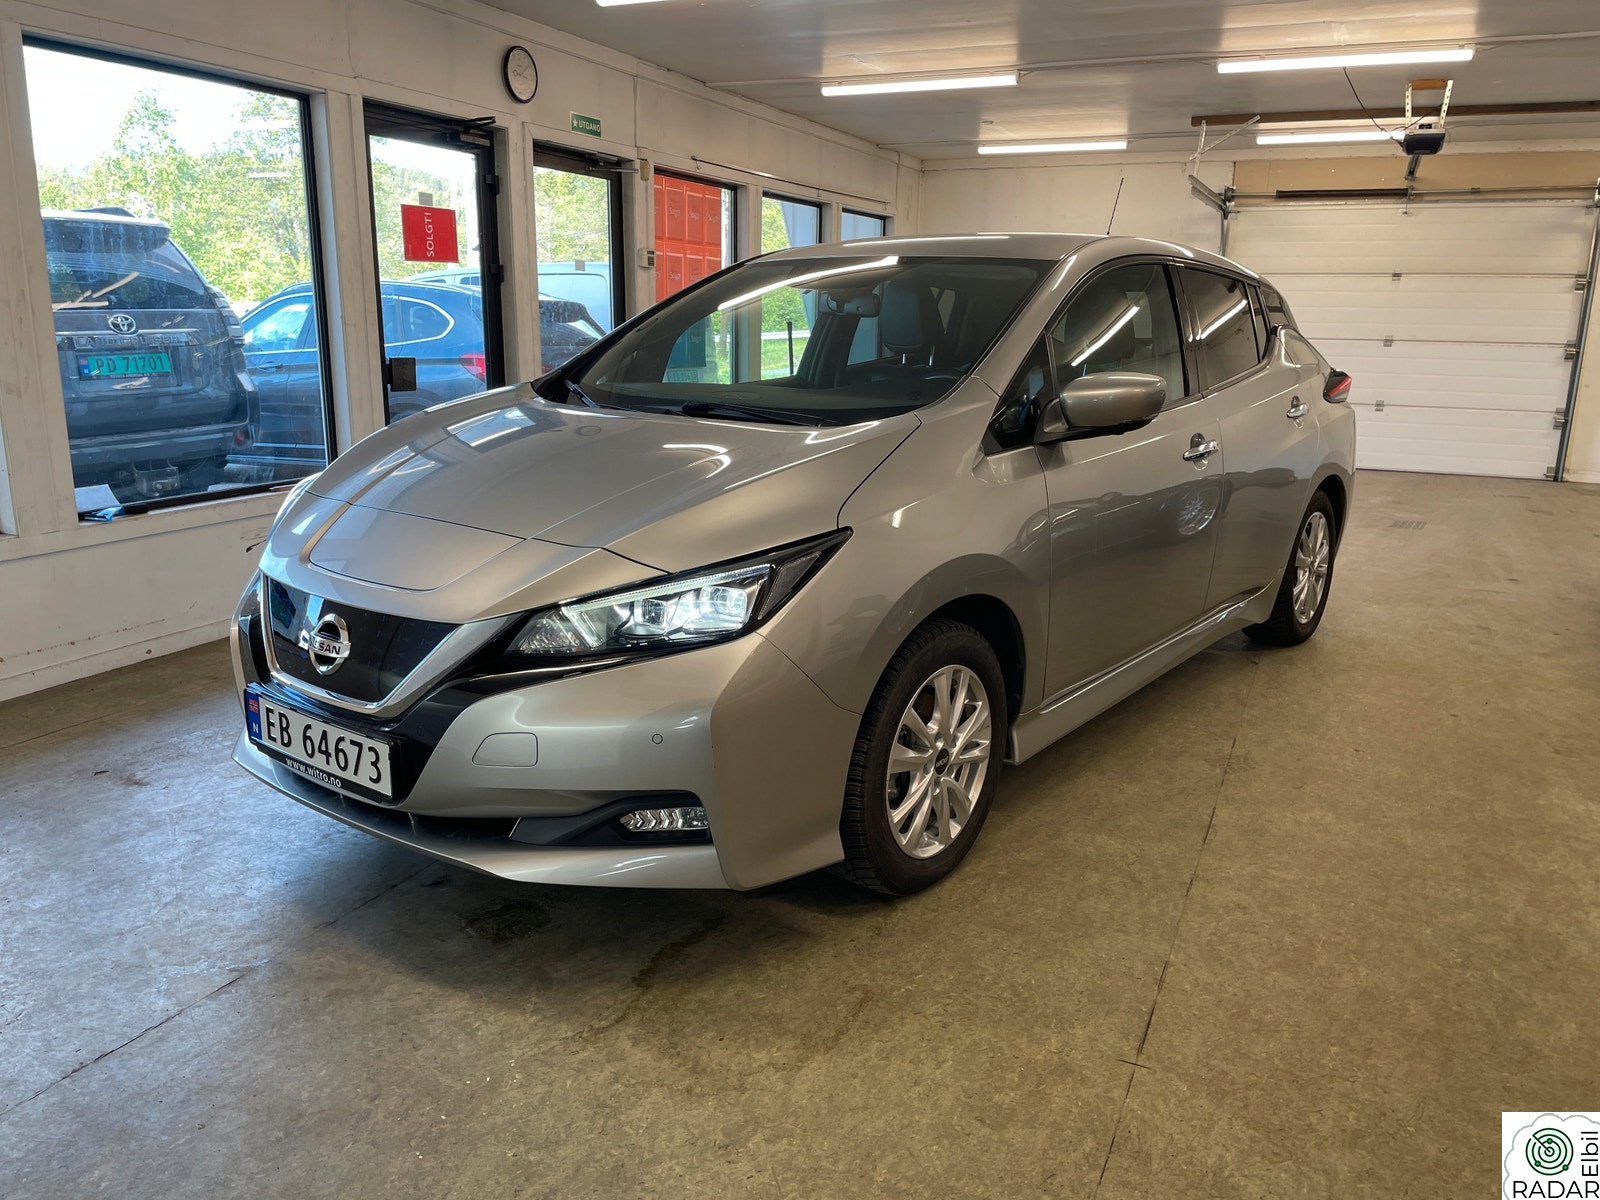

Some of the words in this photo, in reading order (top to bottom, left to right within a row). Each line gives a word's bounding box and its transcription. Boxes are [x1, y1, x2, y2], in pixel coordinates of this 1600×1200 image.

[424, 212, 435, 258] SOLGT!
[120, 335, 178, 346] CRUISER
[96, 358, 117, 373] PD
[121, 355, 165, 372] 71701
[310, 637, 341, 655] SSAN
[252, 722, 259, 734] N
[265, 704, 292, 748] EB
[302, 723, 382, 784] 64673
[285, 756, 342, 788] www.witro.no
